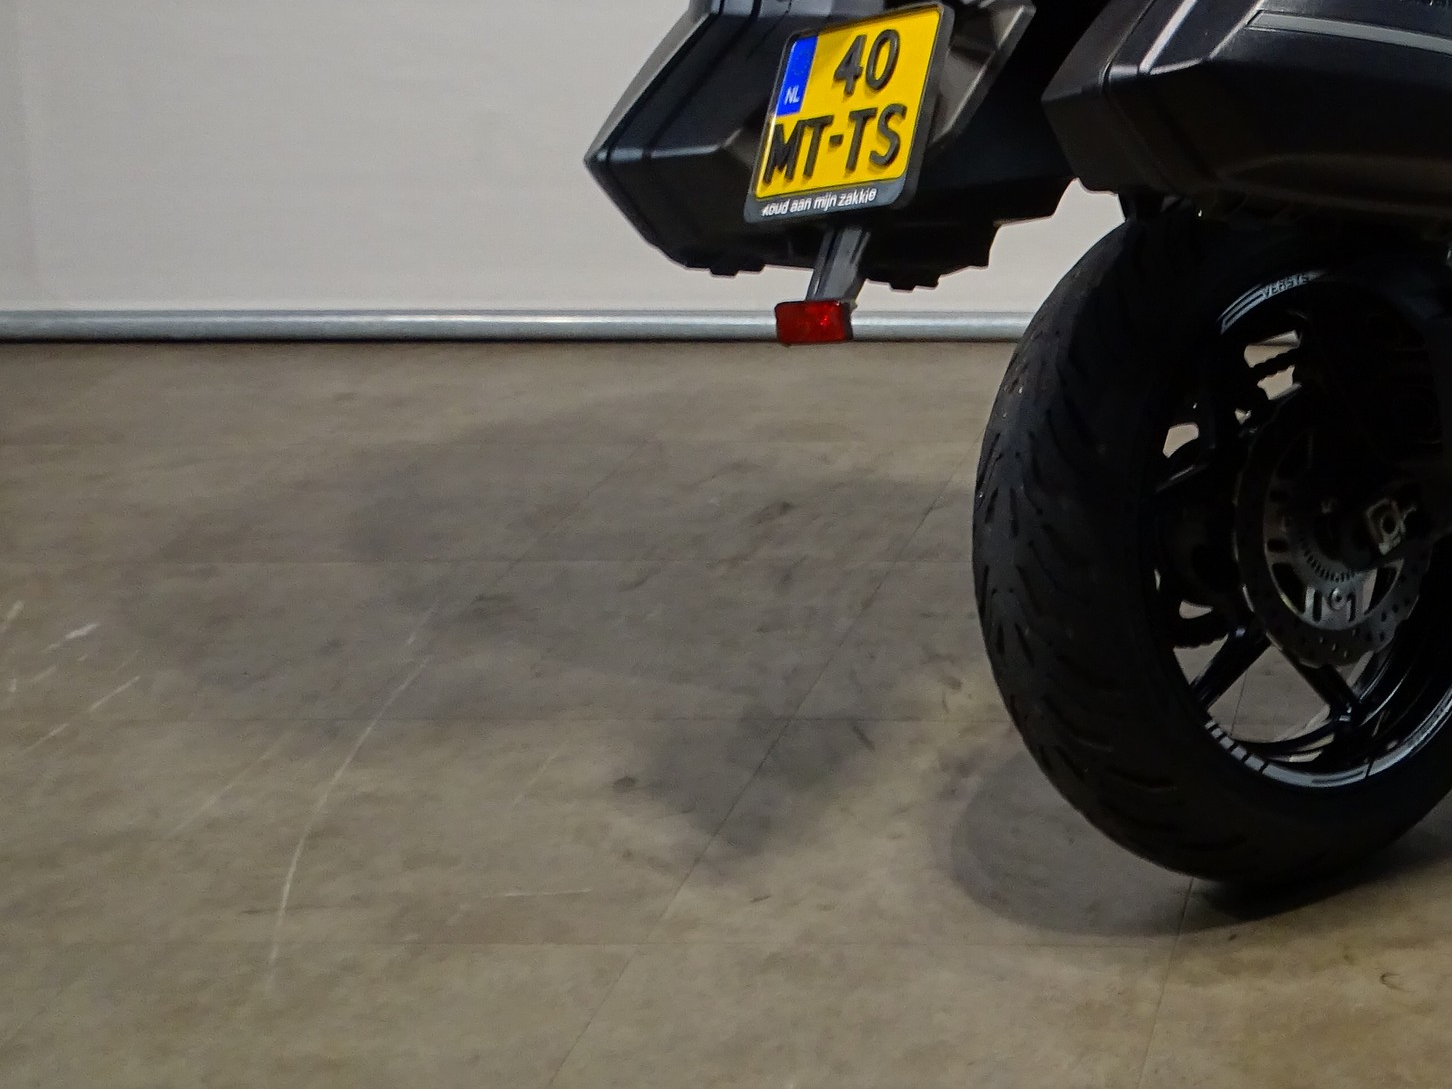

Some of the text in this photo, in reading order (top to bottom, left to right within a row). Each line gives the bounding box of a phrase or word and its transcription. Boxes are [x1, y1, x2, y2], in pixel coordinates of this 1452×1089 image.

[834, 29, 900, 95] 40
[785, 87, 800, 105] NL
[763, 103, 908, 184] MT-TS
[790, 197, 812, 213] aan
[814, 192, 838, 211] mijn
[838, 188, 877, 207] zakkie
